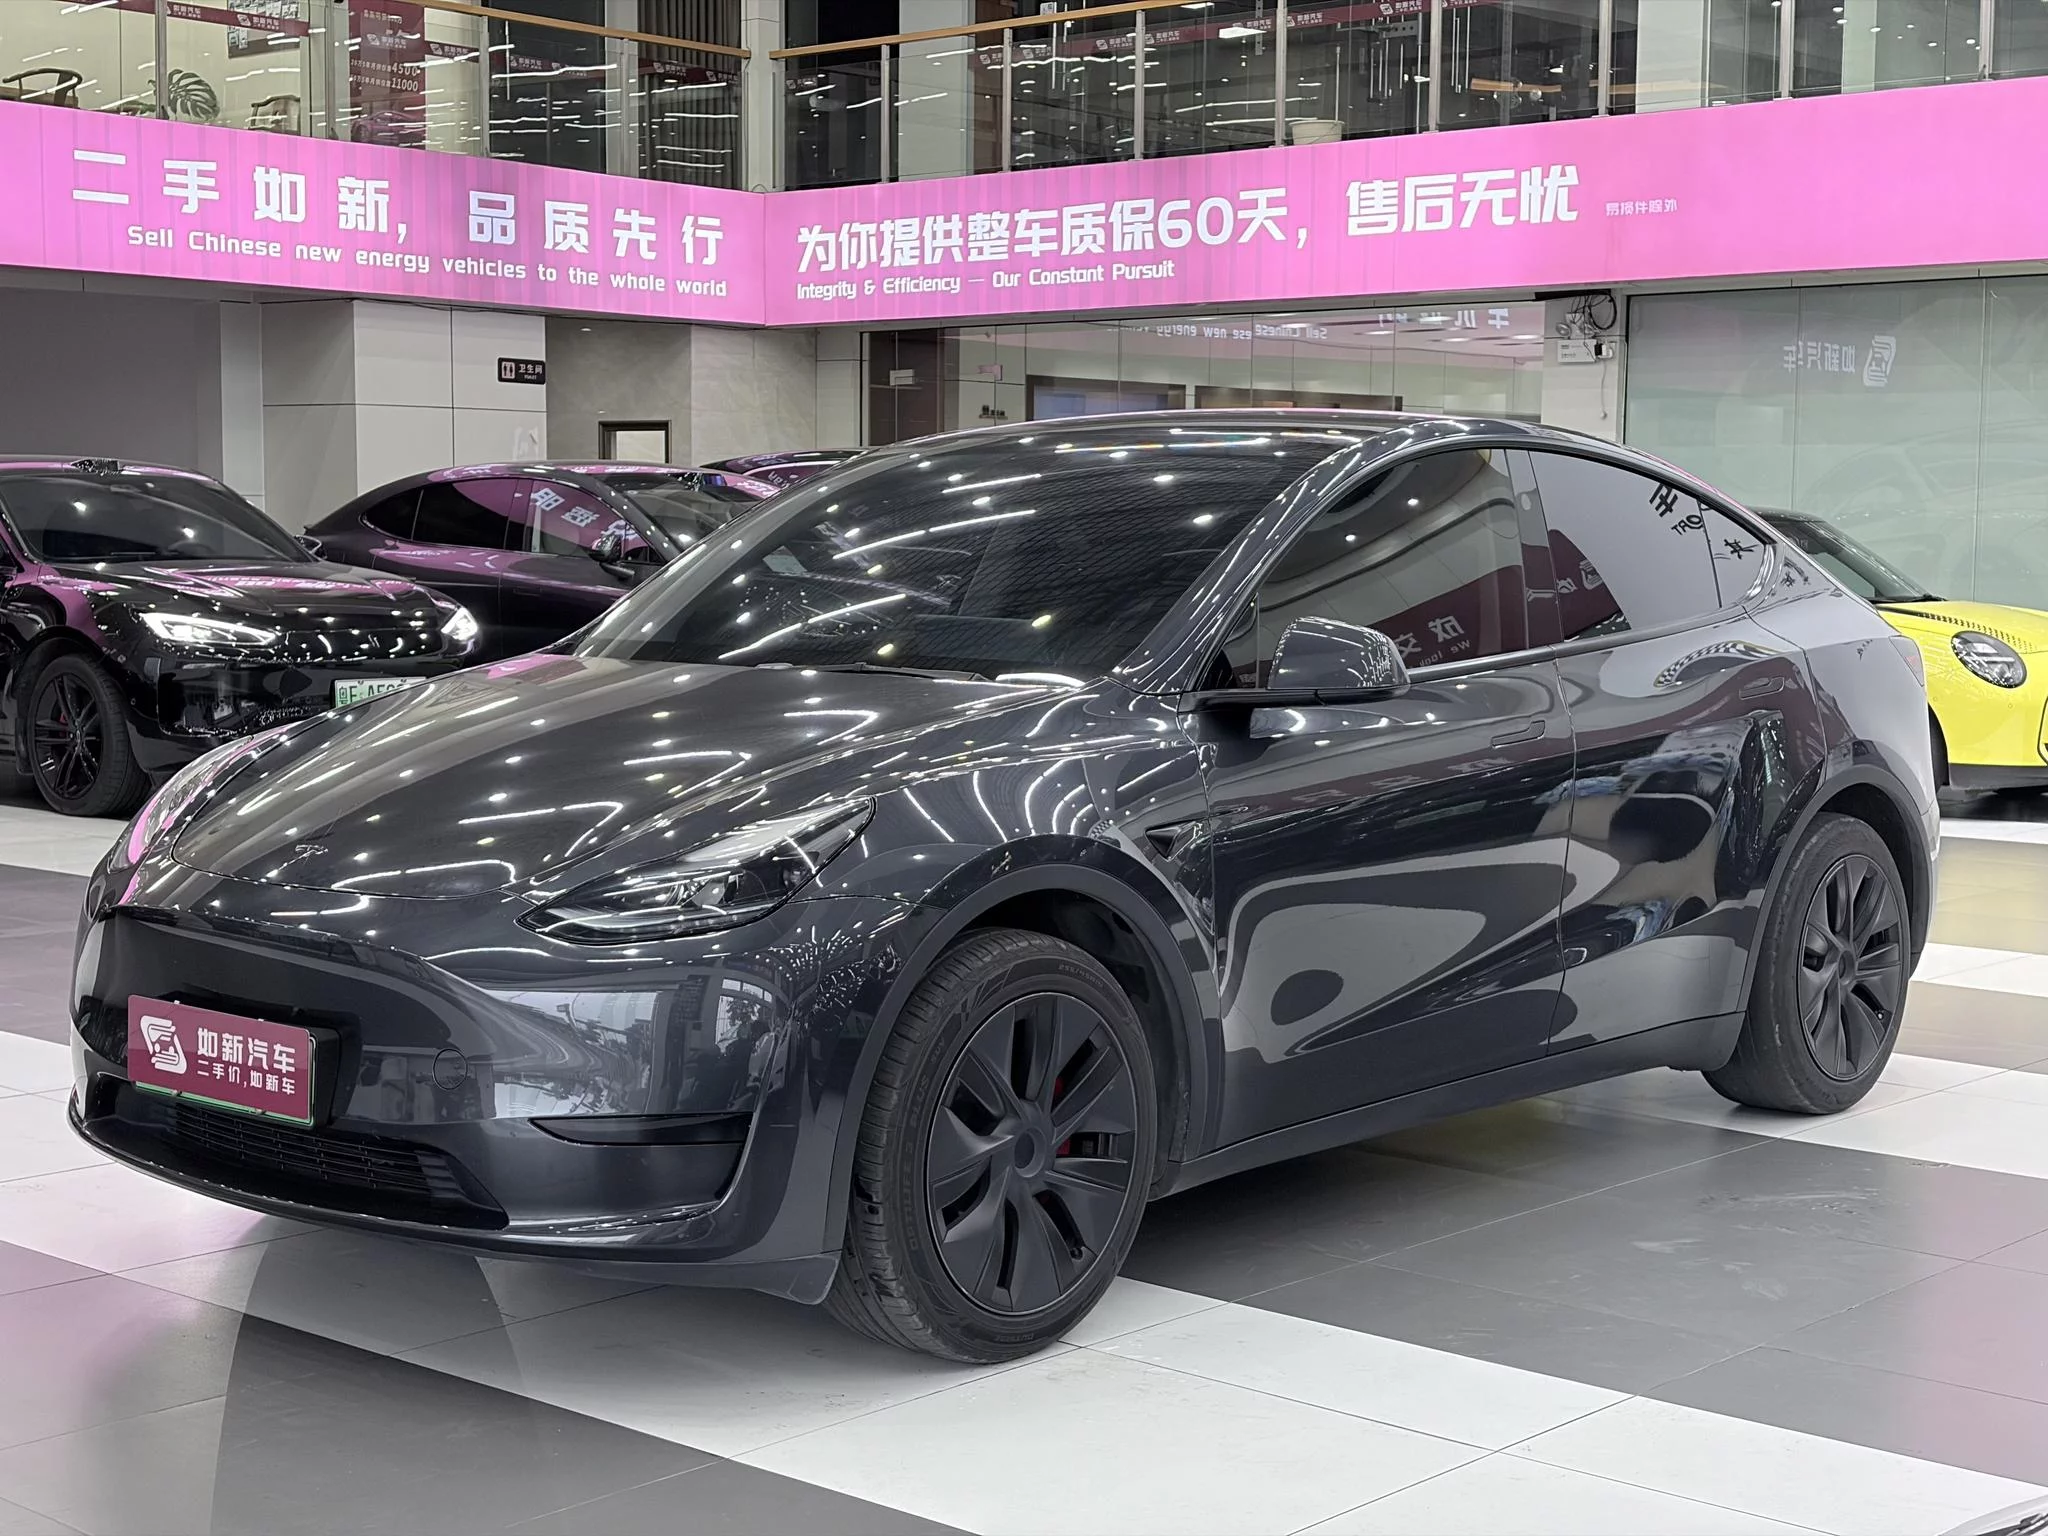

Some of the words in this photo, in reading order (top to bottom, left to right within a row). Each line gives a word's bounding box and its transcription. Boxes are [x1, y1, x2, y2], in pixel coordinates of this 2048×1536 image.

[127, 225, 174, 249] Sell
[188, 231, 281, 258] Chinese
[295, 244, 342, 262] new
[355, 249, 430, 273] energy
[442, 256, 526, 279] vehicles
[537, 263, 557, 282] to
[568, 265, 599, 286] the
[610, 271, 666, 292] whole
[676, 278, 728, 297] world
[796, 281, 857, 301] Integrity
[863, 278, 877, 296] &
[882, 275, 961, 295] Efficiency
[992, 270, 1022, 288] Our
[1028, 264, 1104, 285] Constant
[1111, 259, 1175, 280] Pursuit
[518, 363, 543, 375] 卫生间
[196, 1027, 296, 1074] 如新汽车
[196, 1059, 296, 1096] 二手价，如新车
